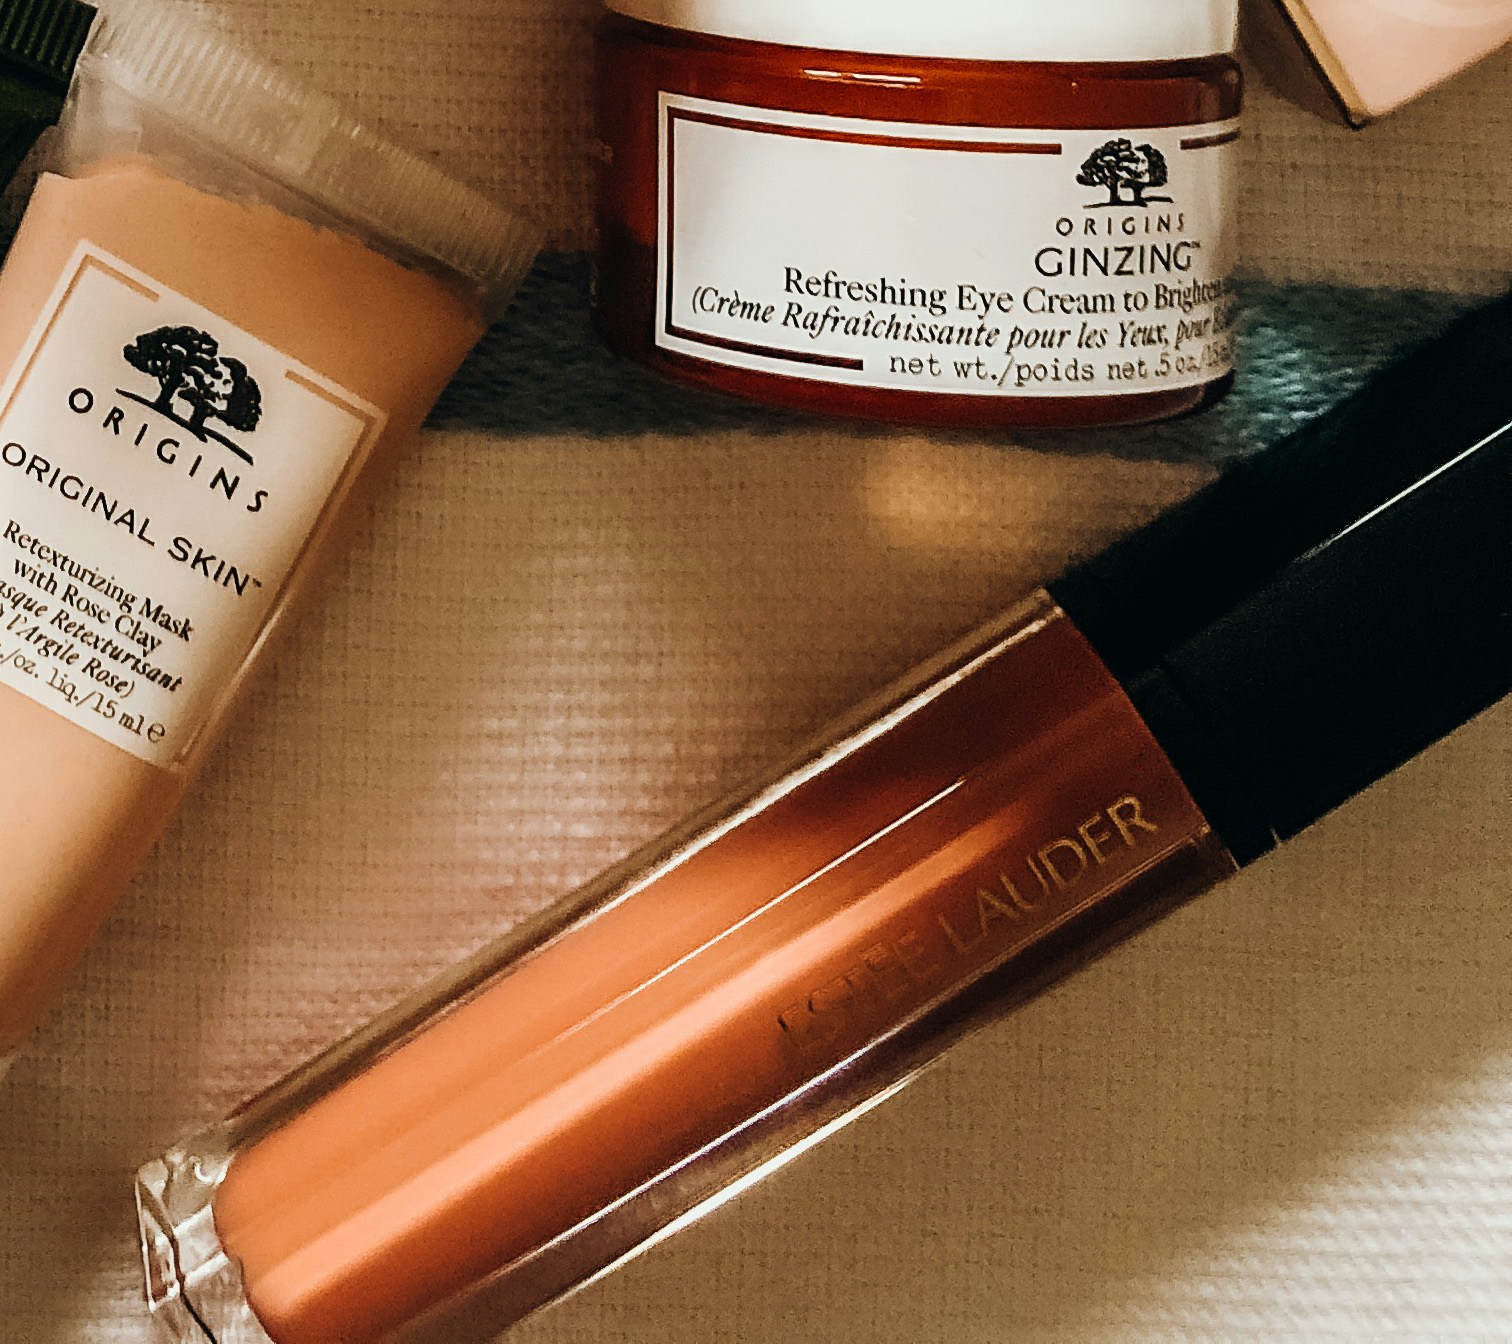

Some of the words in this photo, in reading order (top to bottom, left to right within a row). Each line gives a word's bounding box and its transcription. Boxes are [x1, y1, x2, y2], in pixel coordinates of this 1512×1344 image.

[1056, 213, 1185, 236] ORIGINS
[690, 285, 775, 324] (Crème
[781, 302, 999, 349] Rafraîchissante
[1005, 323, 1072, 354] pour
[1077, 321, 1108, 348] les
[783, 266, 948, 315] Refreshing
[958, 284, 1014, 319] Eye
[1023, 287, 1115, 314] Cream
[1124, 291, 1148, 311] to
[889, 353, 942, 377] net
[953, 355, 1095, 387] wt./poids
[1107, 357, 1148, 380] net
[68, 387, 268, 513] ORIGINS
[1, 442, 155, 547] ORIGINAL
[2, 520, 138, 608] Retexturizing
[139, 597, 195, 642] Mask
[14, 559, 58, 594] with
[61, 584, 111, 625] Rose
[114, 614, 163, 658] Clay
[49, 610, 184, 693] Retexturisant
[81, 656, 136, 698] Rose)
